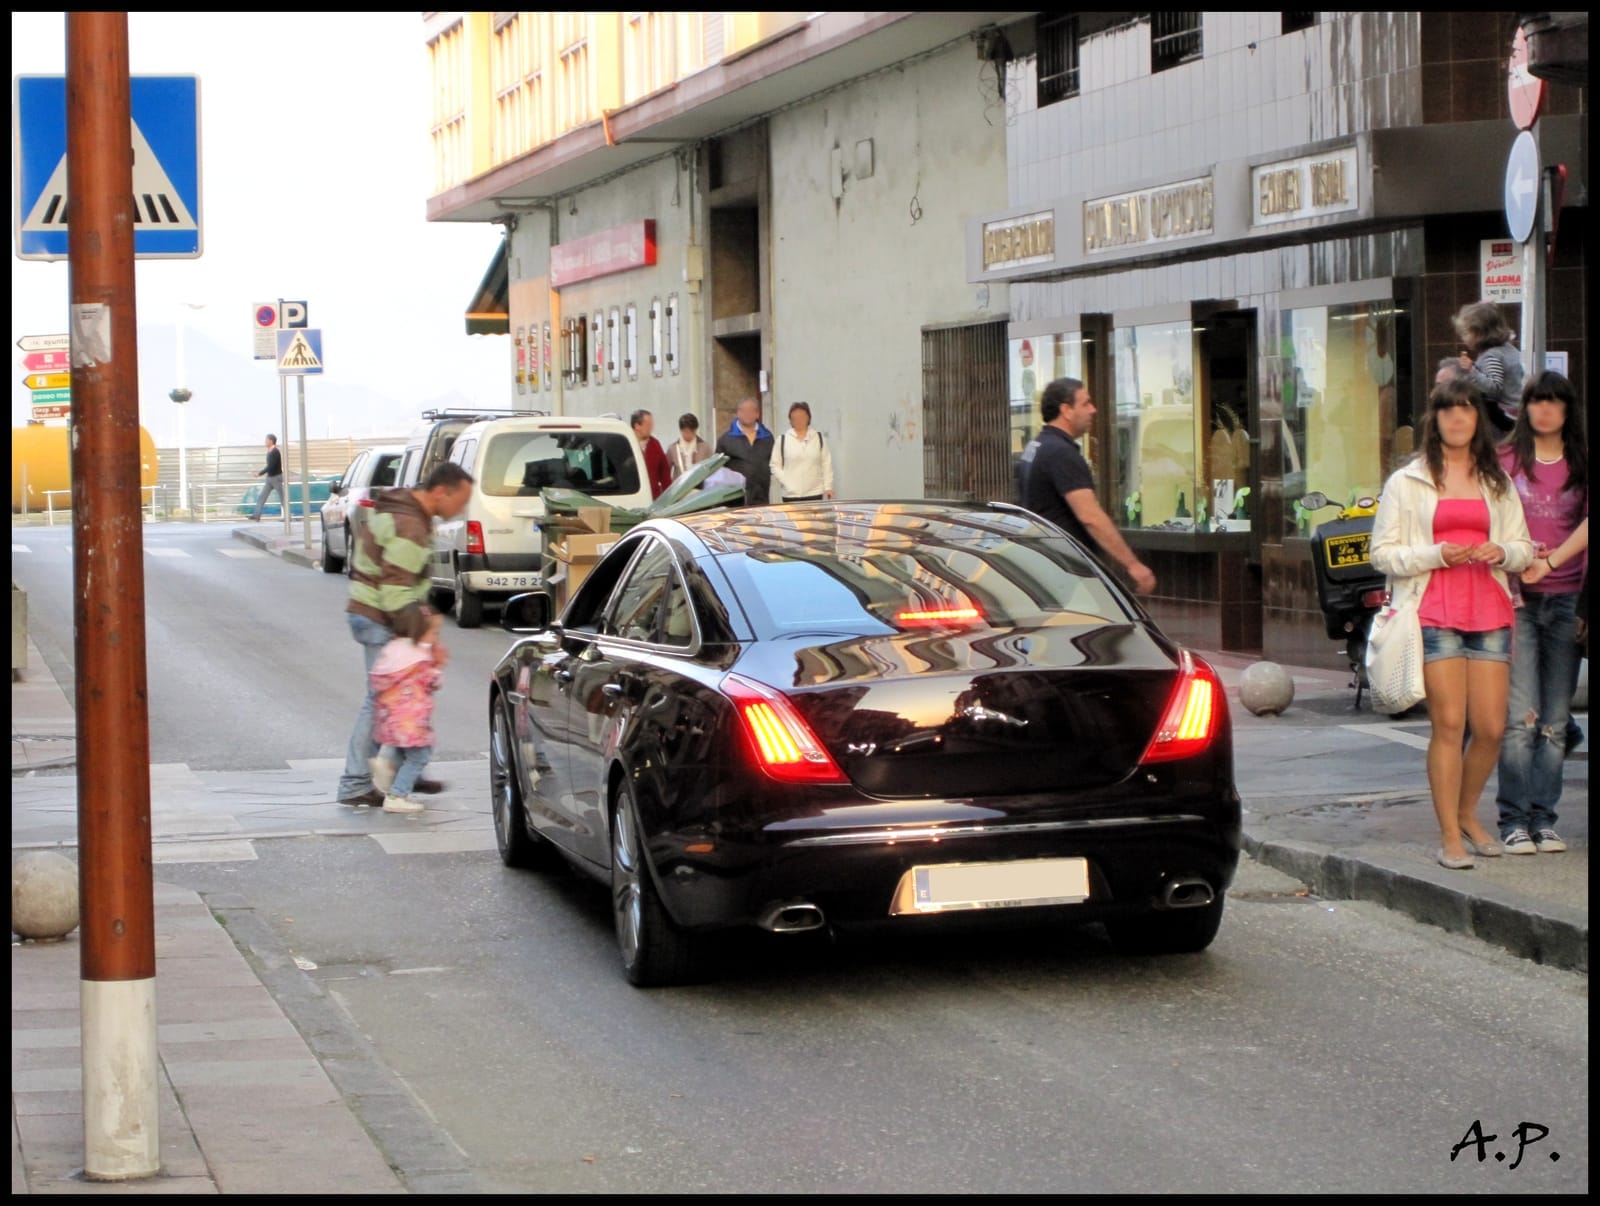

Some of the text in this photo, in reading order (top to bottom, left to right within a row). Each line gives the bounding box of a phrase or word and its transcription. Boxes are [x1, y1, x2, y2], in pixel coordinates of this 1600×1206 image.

[1485, 274, 1521, 284] ALARMA
[281, 302, 305, 328] P
[1338, 553, 1360, 564] 942
[486, 577, 509, 586] 942
[512, 577, 527, 586] 78
[920, 889, 927, 898] E
